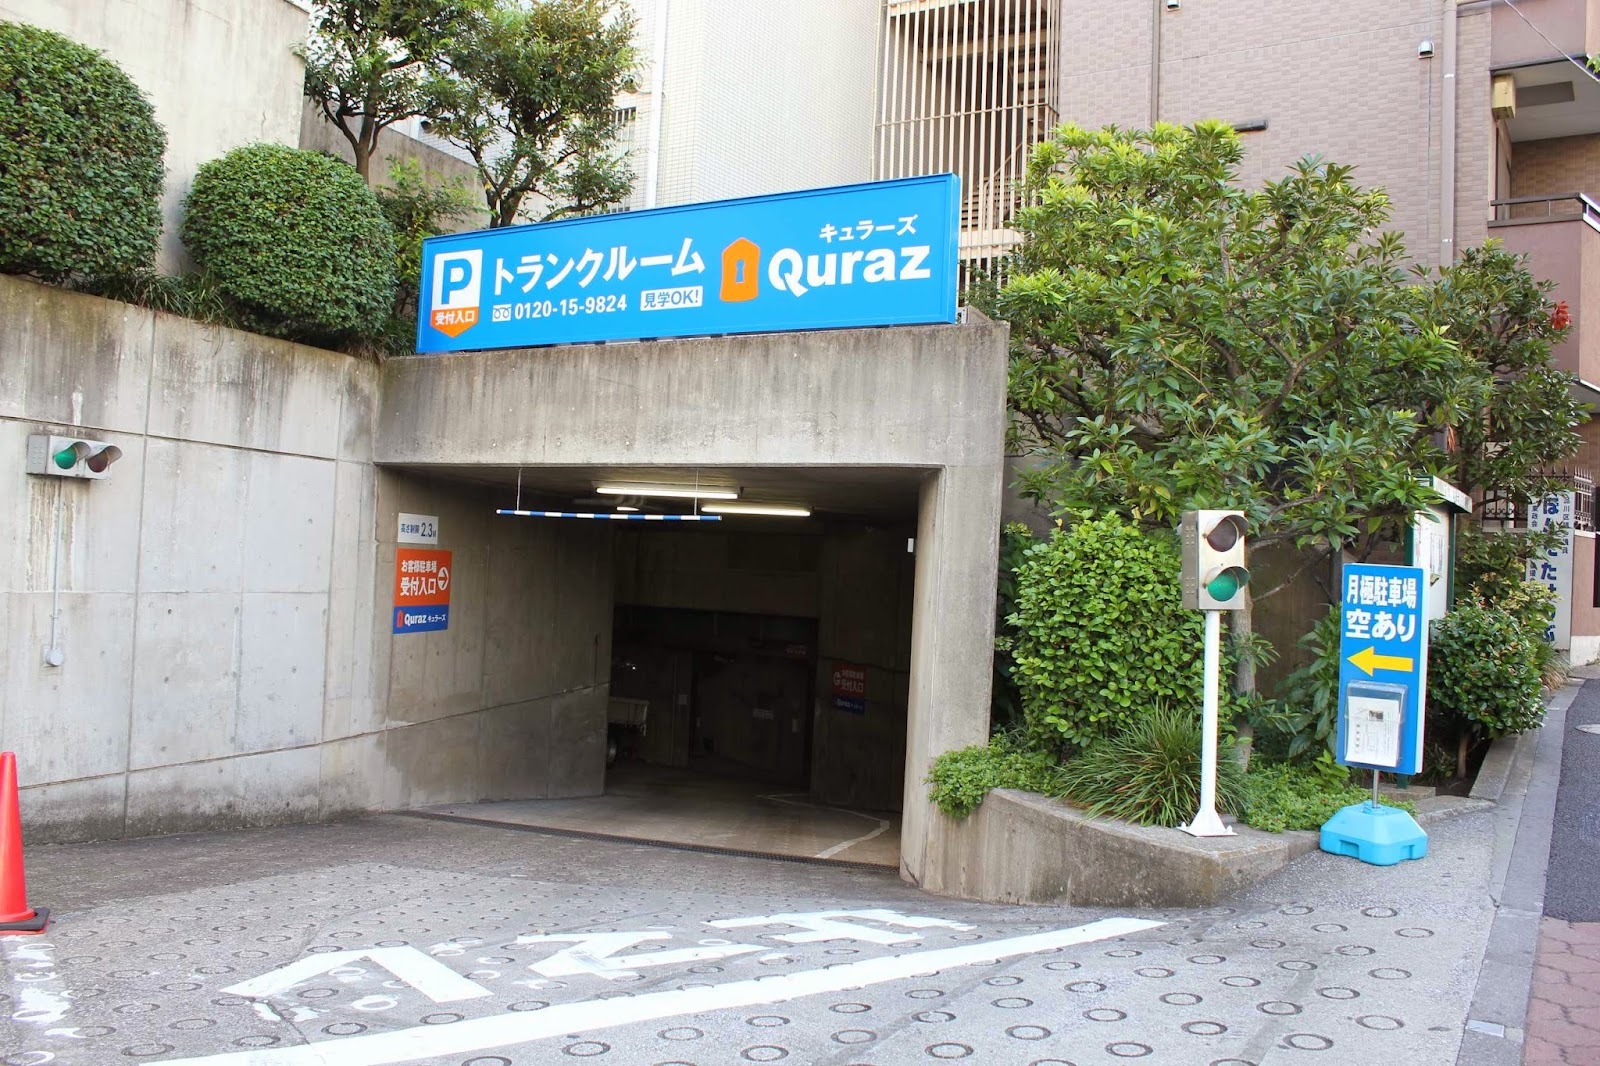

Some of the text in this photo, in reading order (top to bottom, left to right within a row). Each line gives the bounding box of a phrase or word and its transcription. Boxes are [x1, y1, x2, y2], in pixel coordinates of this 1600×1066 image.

[819, 214, 918, 243] キュラーズ
[440, 257, 473, 305] P
[494, 237, 706, 296] トランクルーム
[768, 245, 931, 298] Quraz
[514, 294, 627, 320] 0120-15-9824
[644, 289, 699, 308] 見学OK!
[434, 311, 476, 326] 受付入口
[400, 577, 437, 596] 受付入口
[1346, 574, 1417, 609] 月極駐車場
[404, 613, 427, 626] Quraz
[1345, 608, 1416, 642] 空あり
